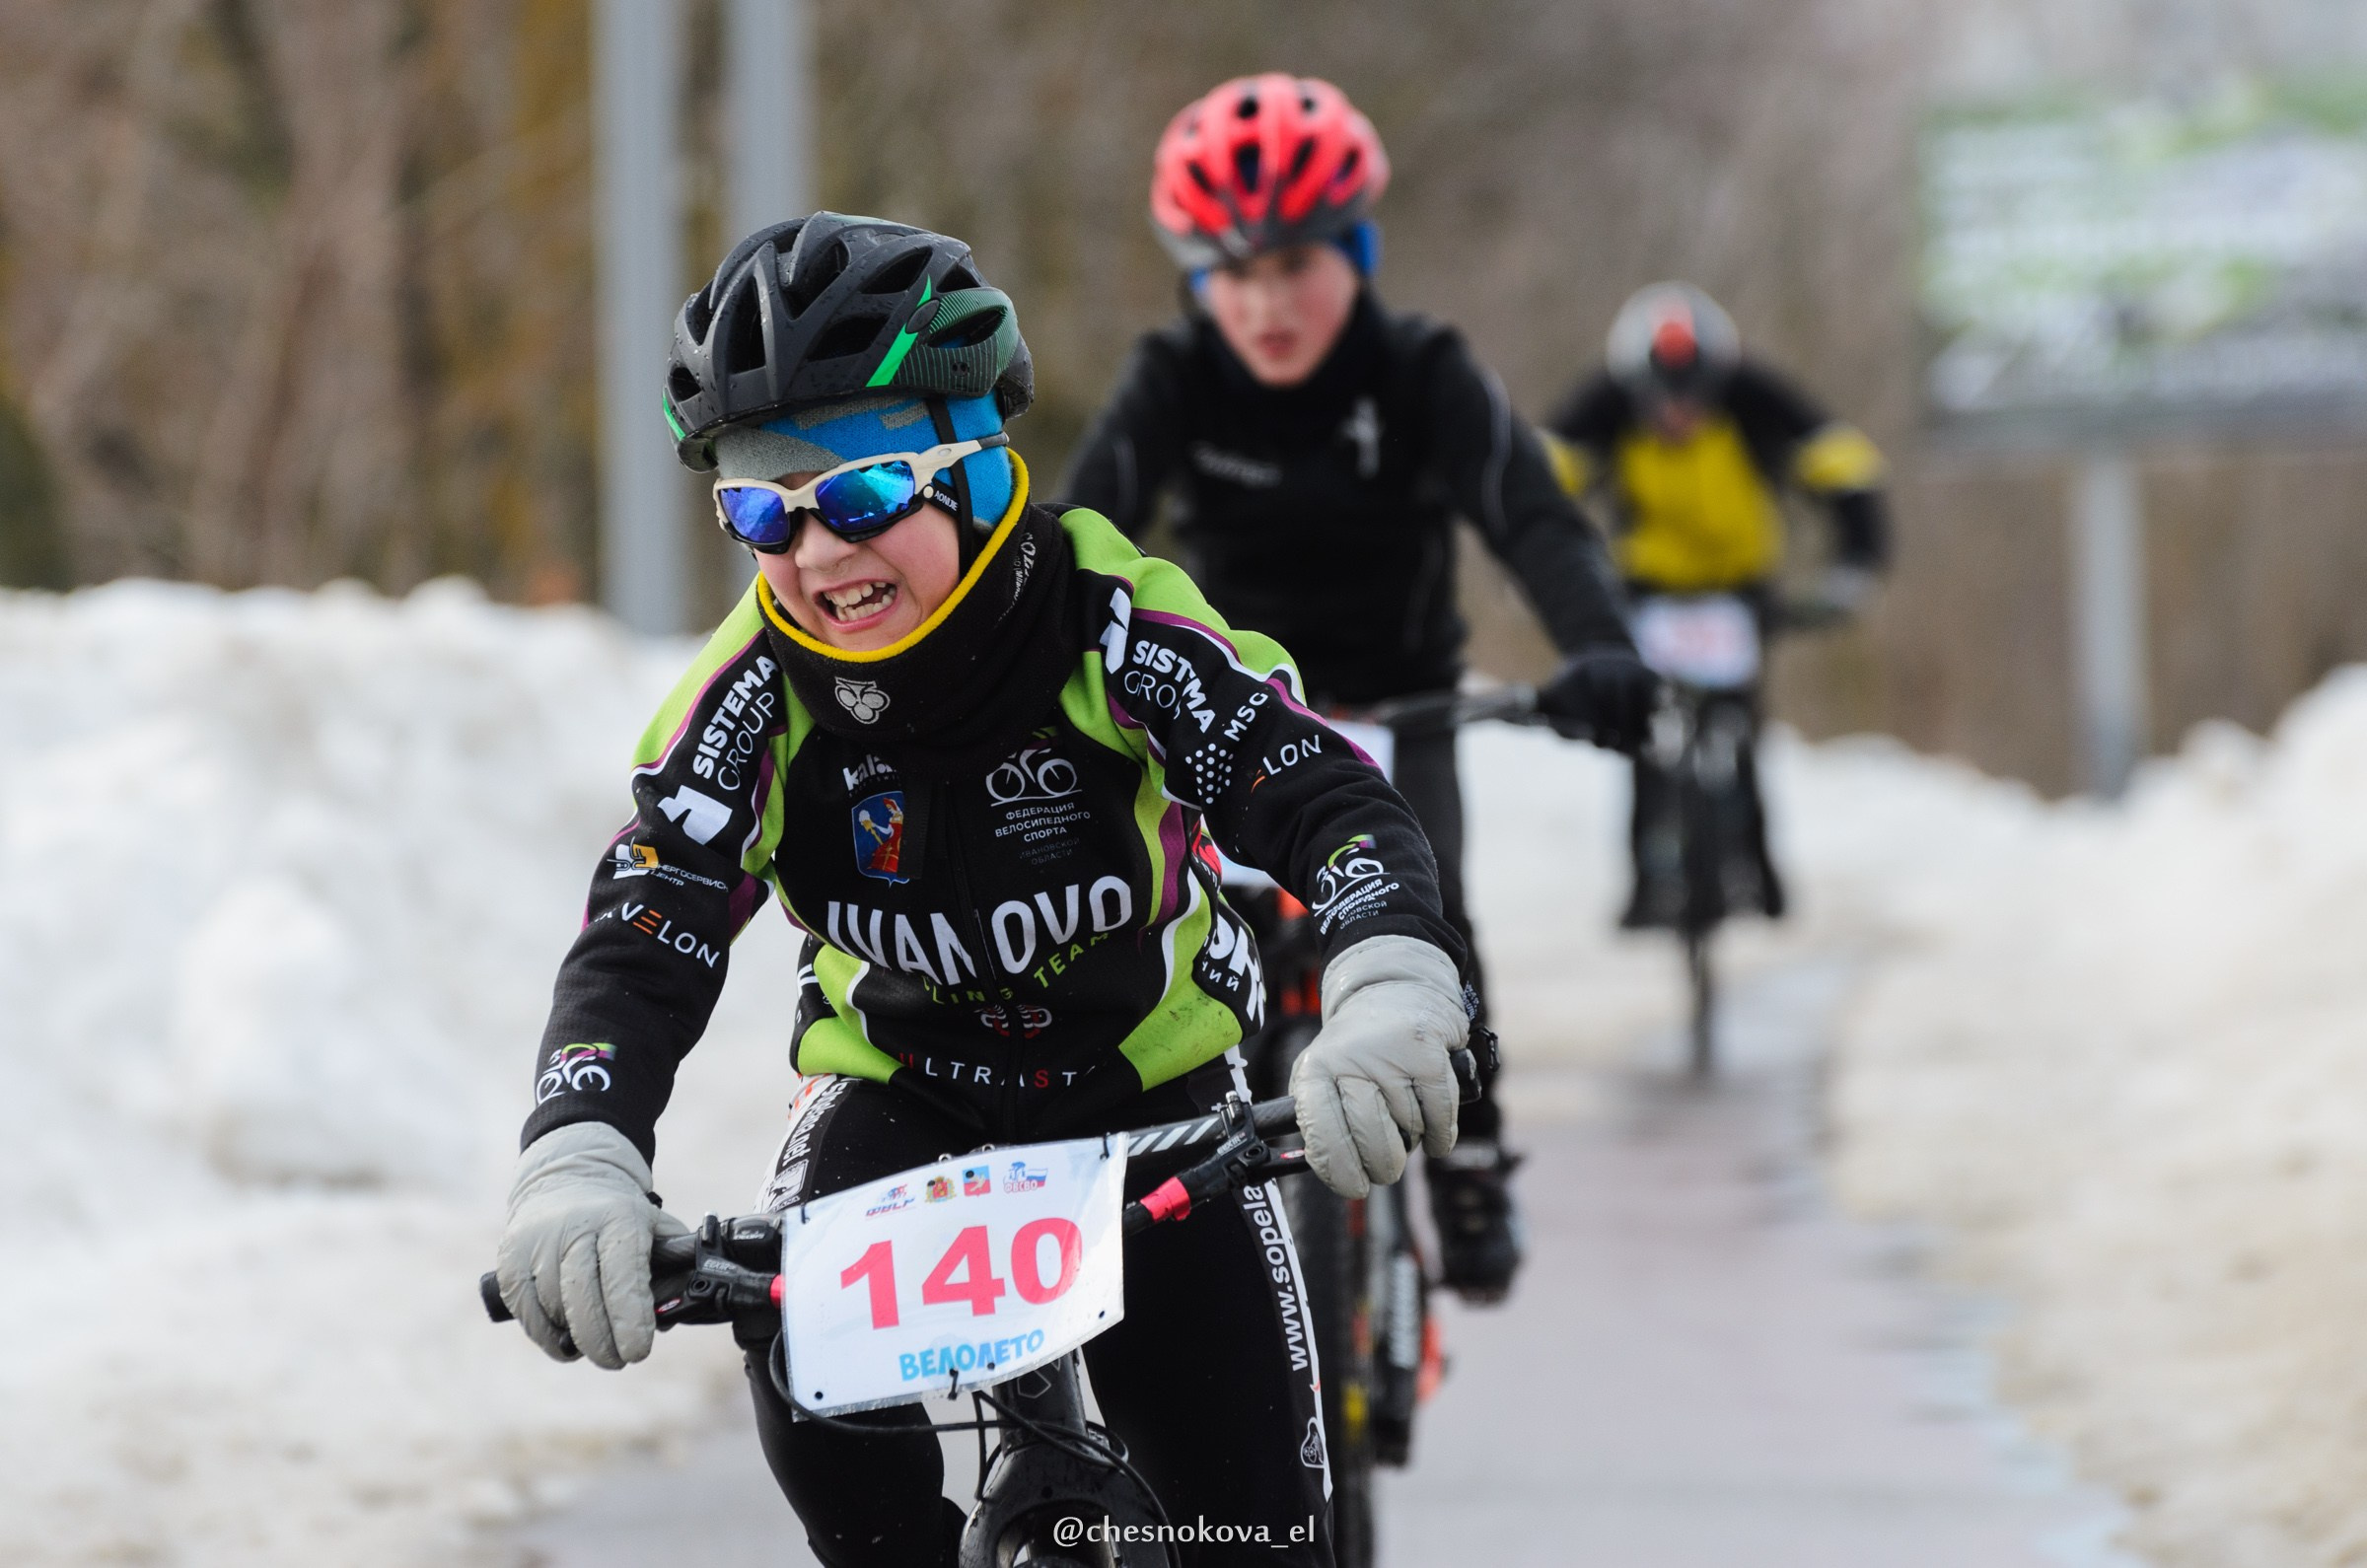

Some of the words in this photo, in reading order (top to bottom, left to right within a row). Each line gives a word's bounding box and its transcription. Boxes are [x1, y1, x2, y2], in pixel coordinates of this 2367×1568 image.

[1132, 640, 1216, 734] SISTMA
[692, 655, 780, 779] SISTEMA
[717, 691, 775, 790] GROUP
[1224, 691, 1268, 742] MSG
[842, 754, 897, 791] kala
[994, 811, 1091, 837] ВЕЛОСИПЕДНОГО
[1005, 802, 1075, 820] ФЕДЕРАЦИЯ
[1023, 826, 1067, 842] СПОРТА
[594, 901, 721, 968] VELON
[826, 875, 1133, 986] IVANOVO
[1034, 932, 1110, 988] TEAM
[840, 1217, 1083, 1330] 140
[898, 1327, 1045, 1382] ВЕЛОЛЕТО
